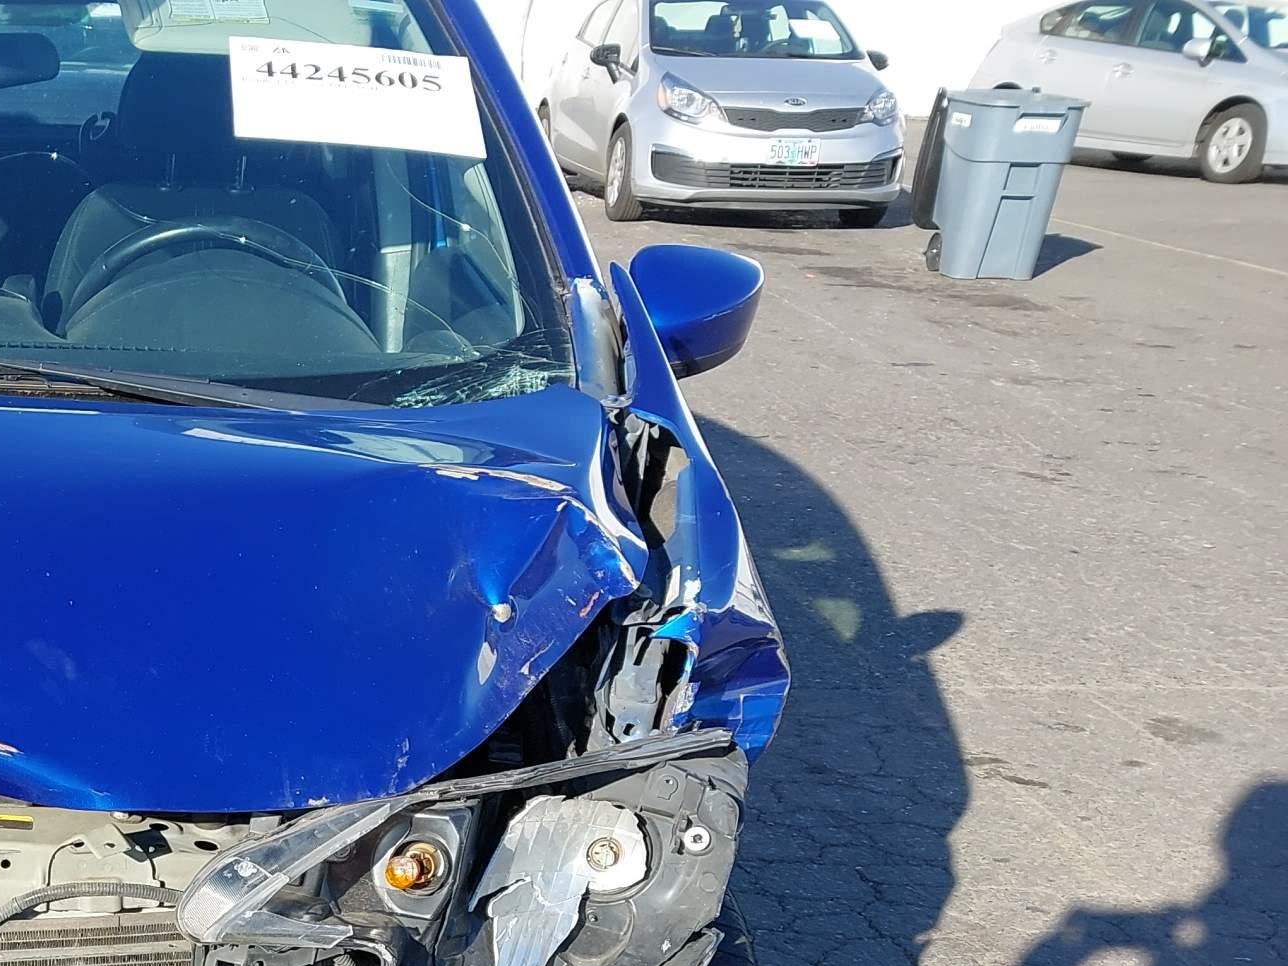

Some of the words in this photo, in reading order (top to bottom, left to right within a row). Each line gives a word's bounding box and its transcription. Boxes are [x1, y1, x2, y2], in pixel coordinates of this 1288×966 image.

[255, 60, 443, 92] 44245605
[770, 144, 791, 159] 503
[796, 144, 817, 160] HWP
